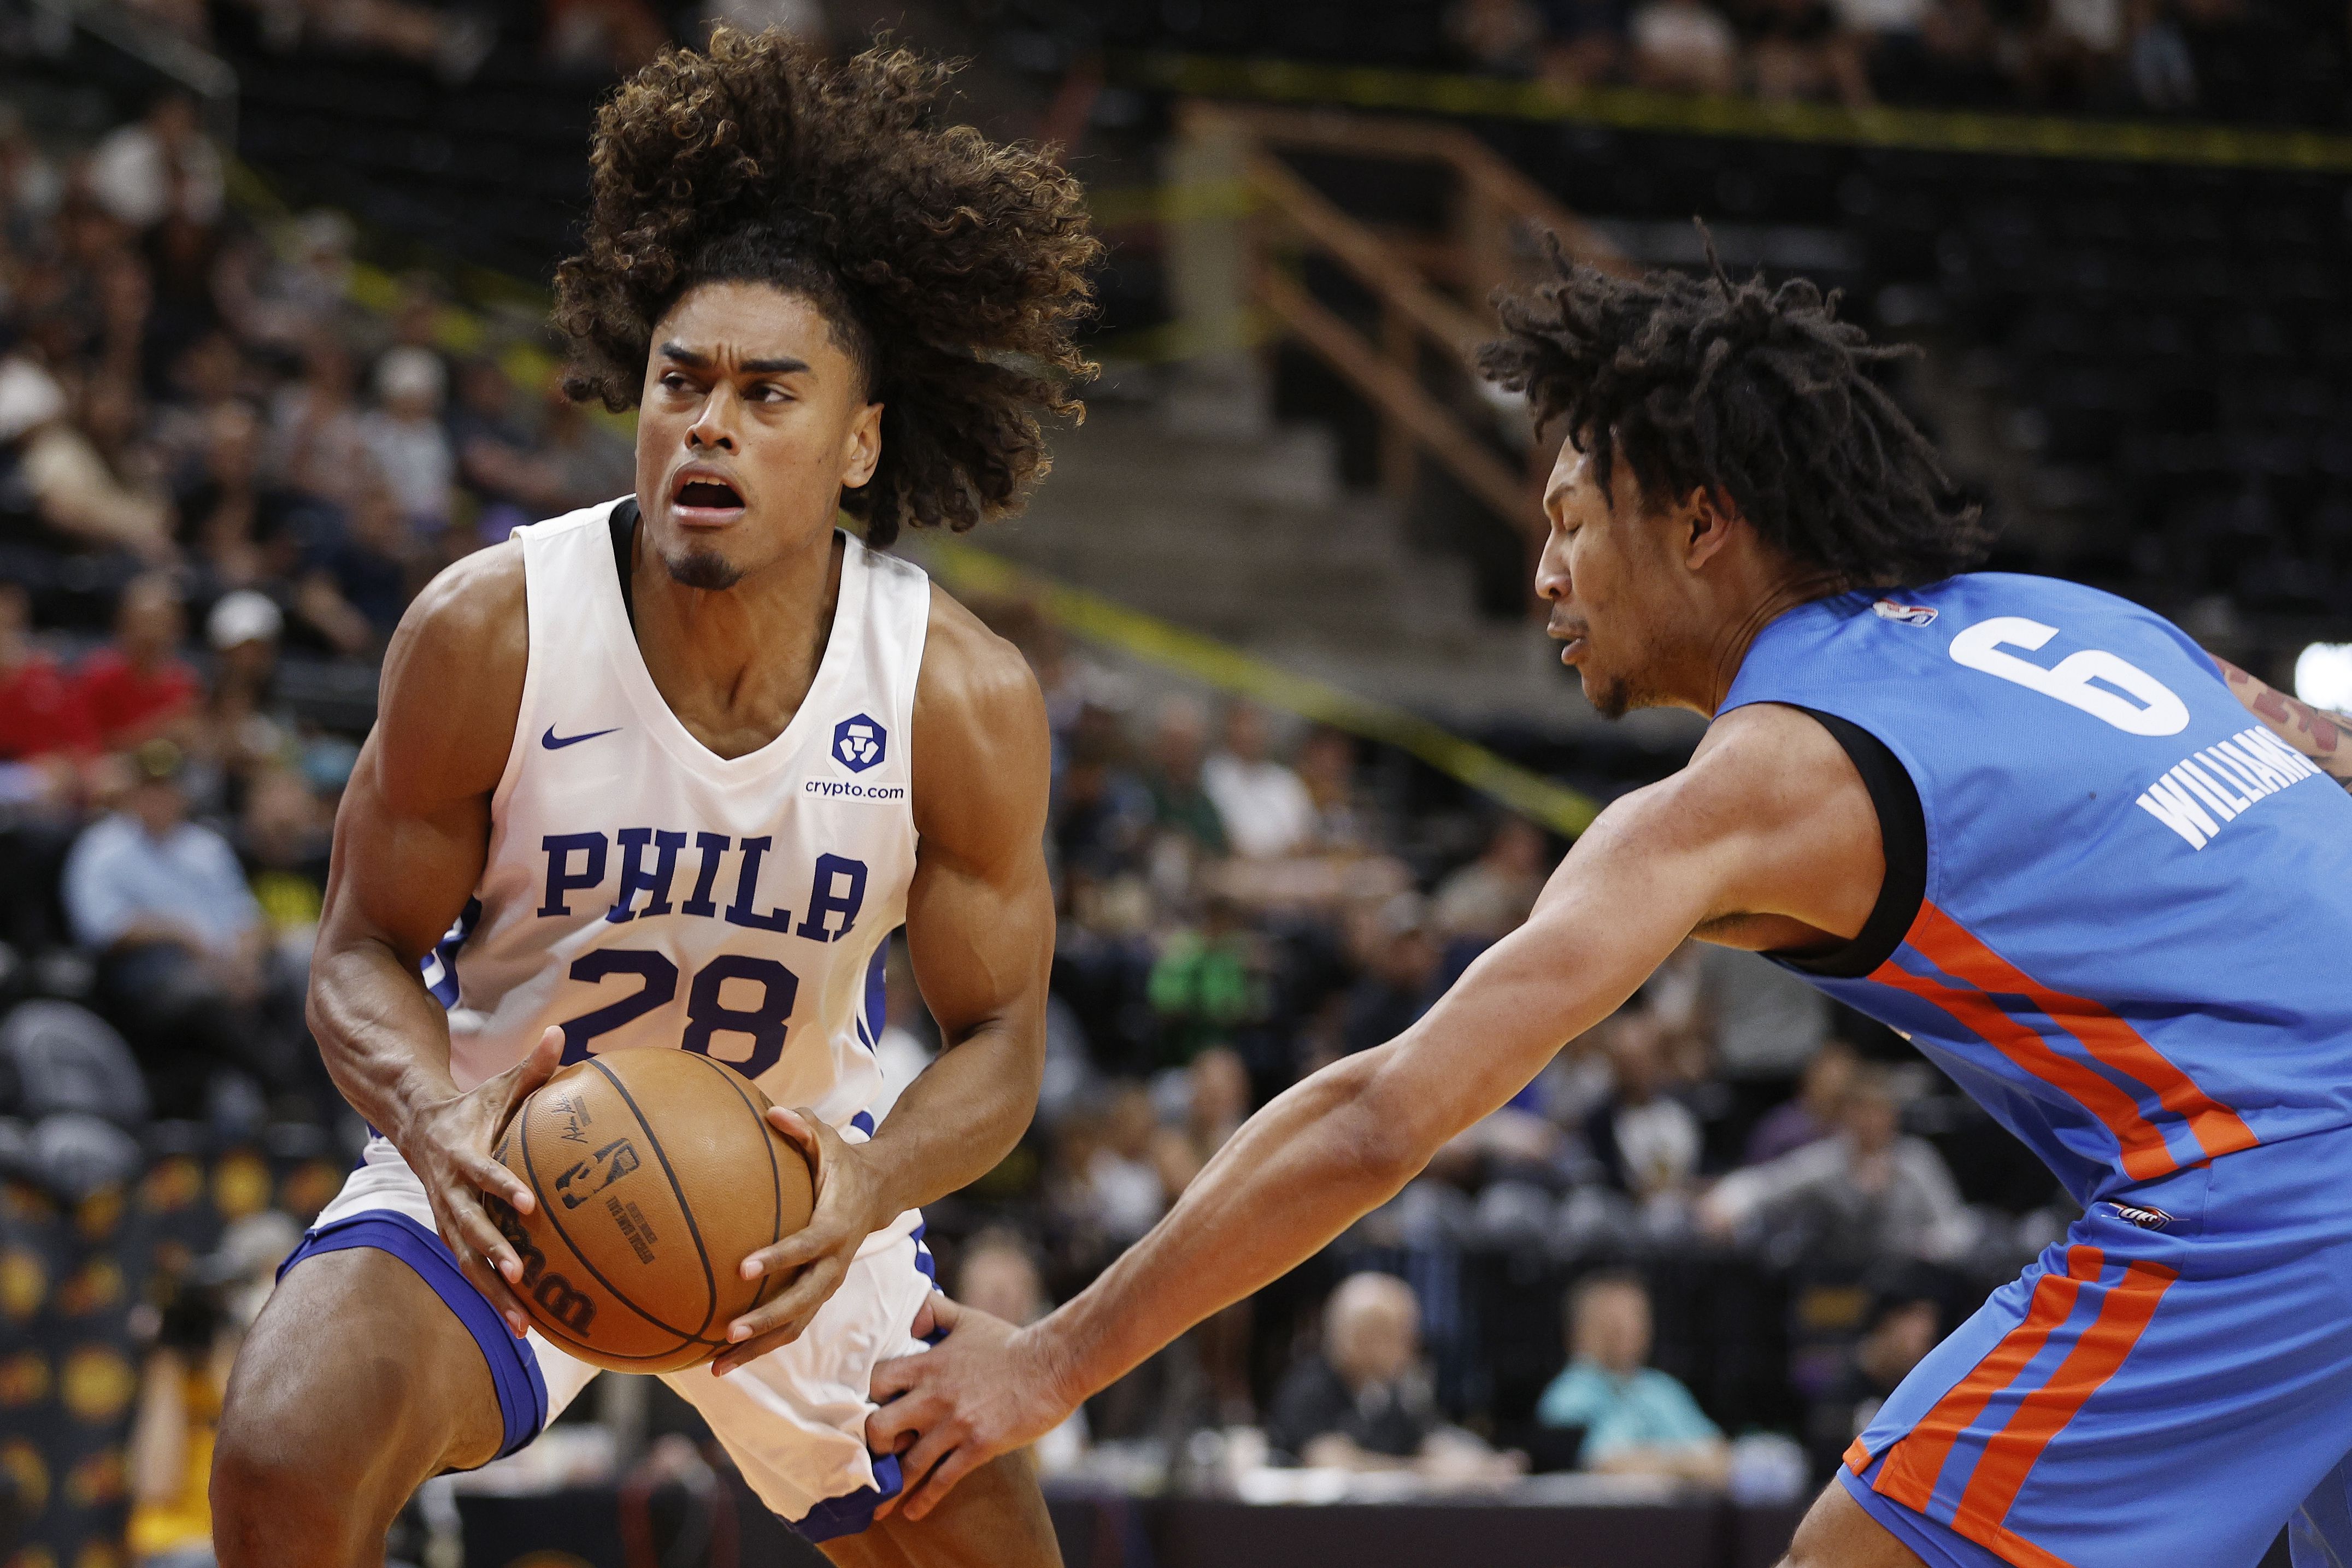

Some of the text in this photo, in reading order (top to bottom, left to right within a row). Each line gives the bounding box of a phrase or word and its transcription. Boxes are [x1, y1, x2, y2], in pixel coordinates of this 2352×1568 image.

[1949, 616, 2190, 736] 6
[805, 778, 904, 799] crypto.com
[2136, 725, 2322, 851] WILLIAMS
[537, 827, 868, 943] PHILA
[559, 948, 799, 1080] 28
